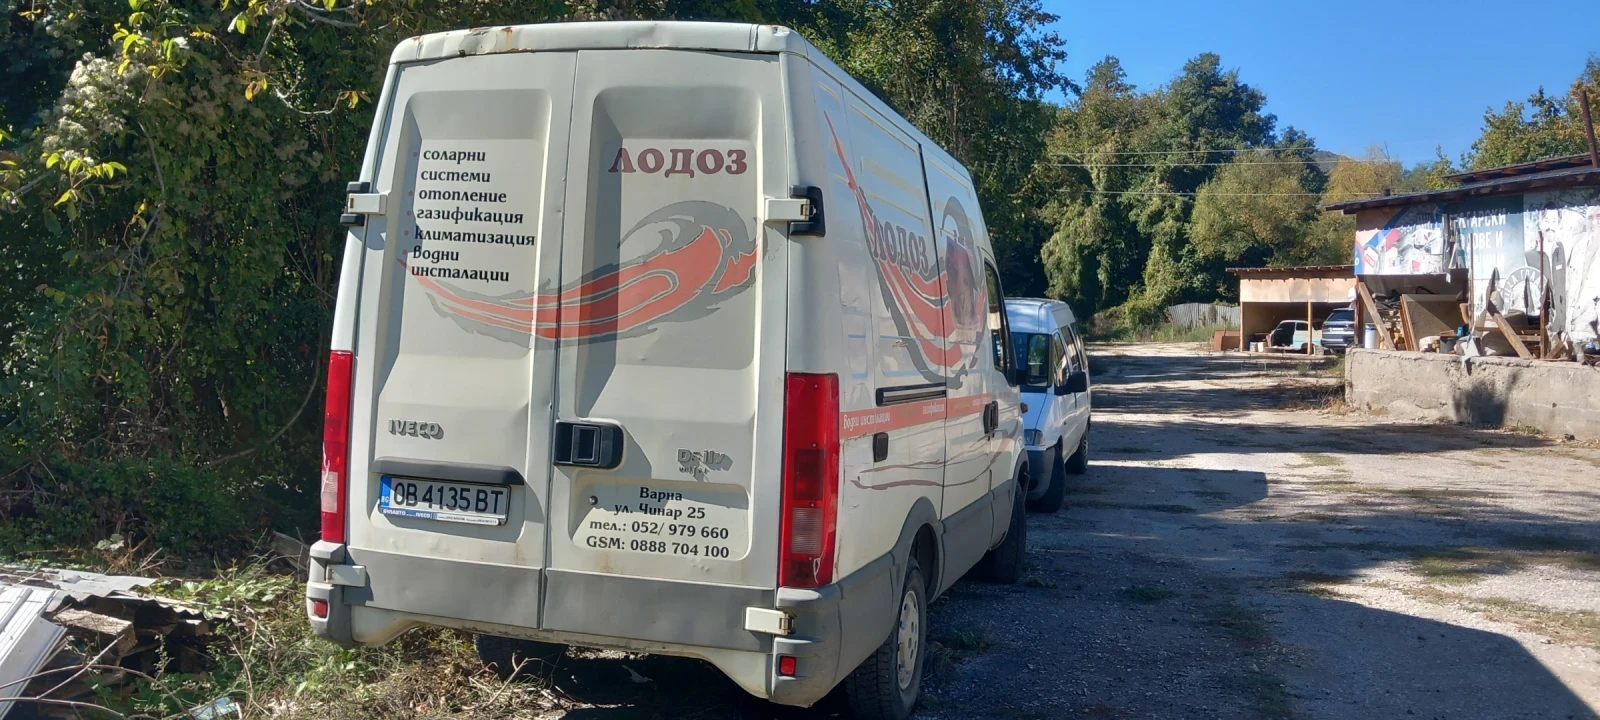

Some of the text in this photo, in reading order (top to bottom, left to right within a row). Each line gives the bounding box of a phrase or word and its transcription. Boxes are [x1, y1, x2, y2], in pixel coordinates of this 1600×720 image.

[423, 149, 486, 165] соларни
[608, 147, 748, 179] ЛОДОЗ
[420, 170, 491, 183] системи
[418, 189, 507, 203] отопление
[416, 206, 524, 225] газификация
[414, 225, 536, 248] климатизация
[412, 245, 460, 264] водни
[410, 265, 510, 283] инсталации
[388, 418, 440, 436] IVECO
[422, 484, 471, 512] 4135
[639, 487, 683, 503] Варна
[613, 503, 706, 520] ул. Чинар 25
[589, 520, 729, 540] тел.: 052/ 979 660
[586, 536, 730, 558] GSM: 0888 704 100
